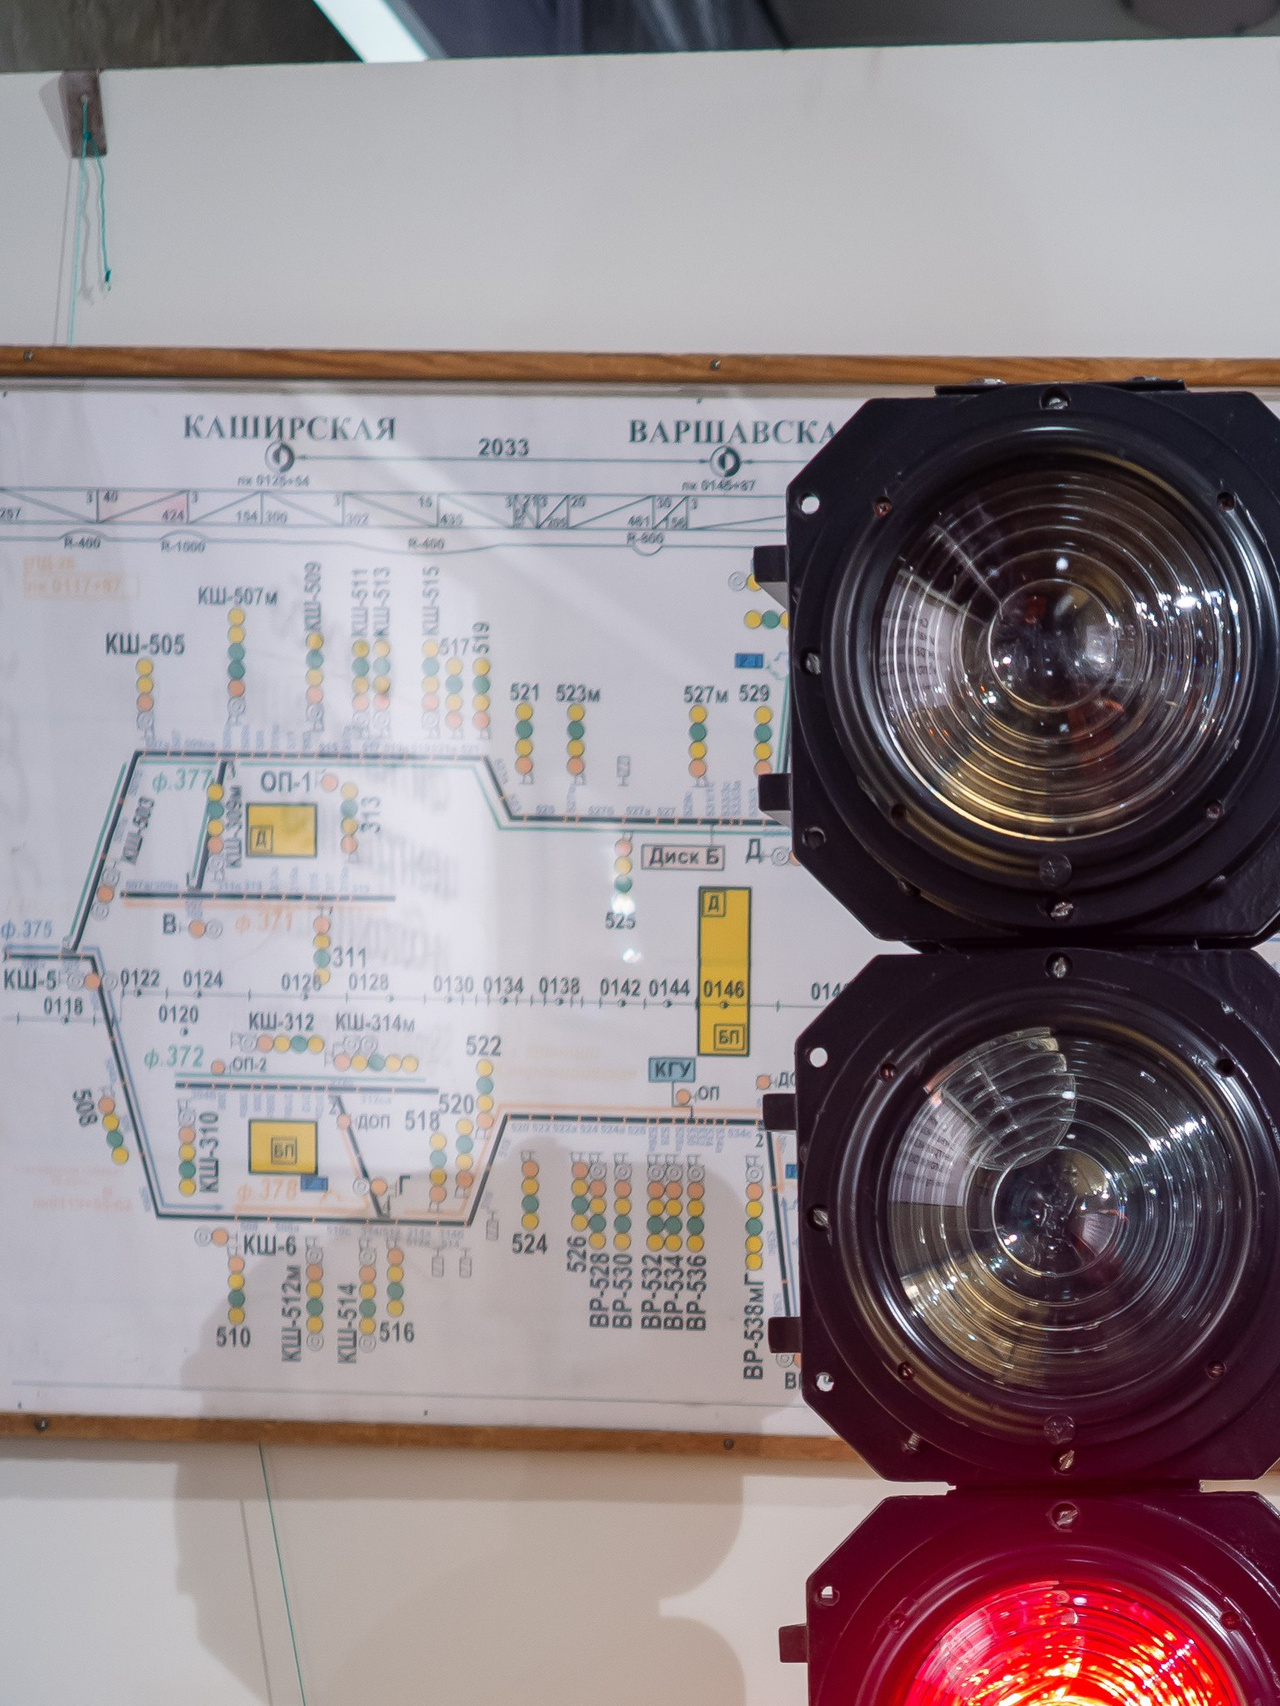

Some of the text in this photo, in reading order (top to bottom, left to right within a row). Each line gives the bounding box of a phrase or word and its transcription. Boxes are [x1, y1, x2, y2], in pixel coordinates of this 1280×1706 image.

[183, 414, 398, 441] КАШИРСКАЯ
[478, 437, 529, 458] 2033
[197, 586, 278, 606] КШ-507м
[422, 565, 440, 635] КШ-515
[105, 631, 186, 656] КШ-505
[439, 638, 470, 656] 517
[472, 621, 491, 654] 519
[510, 682, 540, 702] 521
[555, 683, 600, 703] 523м
[683, 685, 729, 704] 527м
[738, 683, 770, 702] 529
[260, 770, 311, 793] ОП-1
[360, 795, 382, 833] 313
[649, 846, 720, 867] Диск Б
[745, 838, 763, 864] Д
[707, 894, 720, 913] Д
[162, 912, 177, 935] В
[332, 946, 367, 968] 311
[4, 968, 57, 991] КШ-5
[120, 968, 161, 987] 0122
[182, 969, 223, 988] 0124
[348, 972, 390, 992] 0128
[433, 974, 475, 994] 0130
[483, 976, 524, 995] 0134
[539, 976, 581, 995] 0138
[600, 978, 641, 997] 0142
[648, 979, 690, 998] 0144
[703, 980, 745, 998] 0146
[810, 981, 846, 1000] 014
[43, 996, 84, 1015] 0118
[158, 1005, 199, 1024] 0120
[248, 1011, 315, 1031] КШ-312
[335, 1011, 415, 1032] КШ-314м
[465, 1035, 502, 1057] 522
[718, 1029, 740, 1045] БП
[232, 1057, 267, 1073] ОП-2
[654, 1060, 693, 1079] КГУ
[697, 1085, 721, 1101] ОП
[438, 1093, 475, 1115] 520
[357, 1114, 391, 1131] ДОП
[405, 1109, 440, 1131] 518
[199, 1110, 219, 1193] КШ-310
[243, 1234, 297, 1256] КШ-6
[511, 1233, 548, 1255] 524
[566, 1236, 587, 1273] 526
[589, 1253, 610, 1328] ВР-528
[612, 1253, 633, 1329] ВР-530
[641, 1254, 663, 1329] ВР-532
[663, 1254, 684, 1330] ВР-534
[686, 1255, 707, 1331] ВР-536
[281, 1265, 302, 1363] КШ-512м
[337, 1283, 358, 1364] КШ-514
[216, 1326, 251, 1348] 510
[379, 1321, 415, 1343] 516
[743, 1273, 764, 1380] ВР-538мГ
[784, 1372, 801, 1390] В
